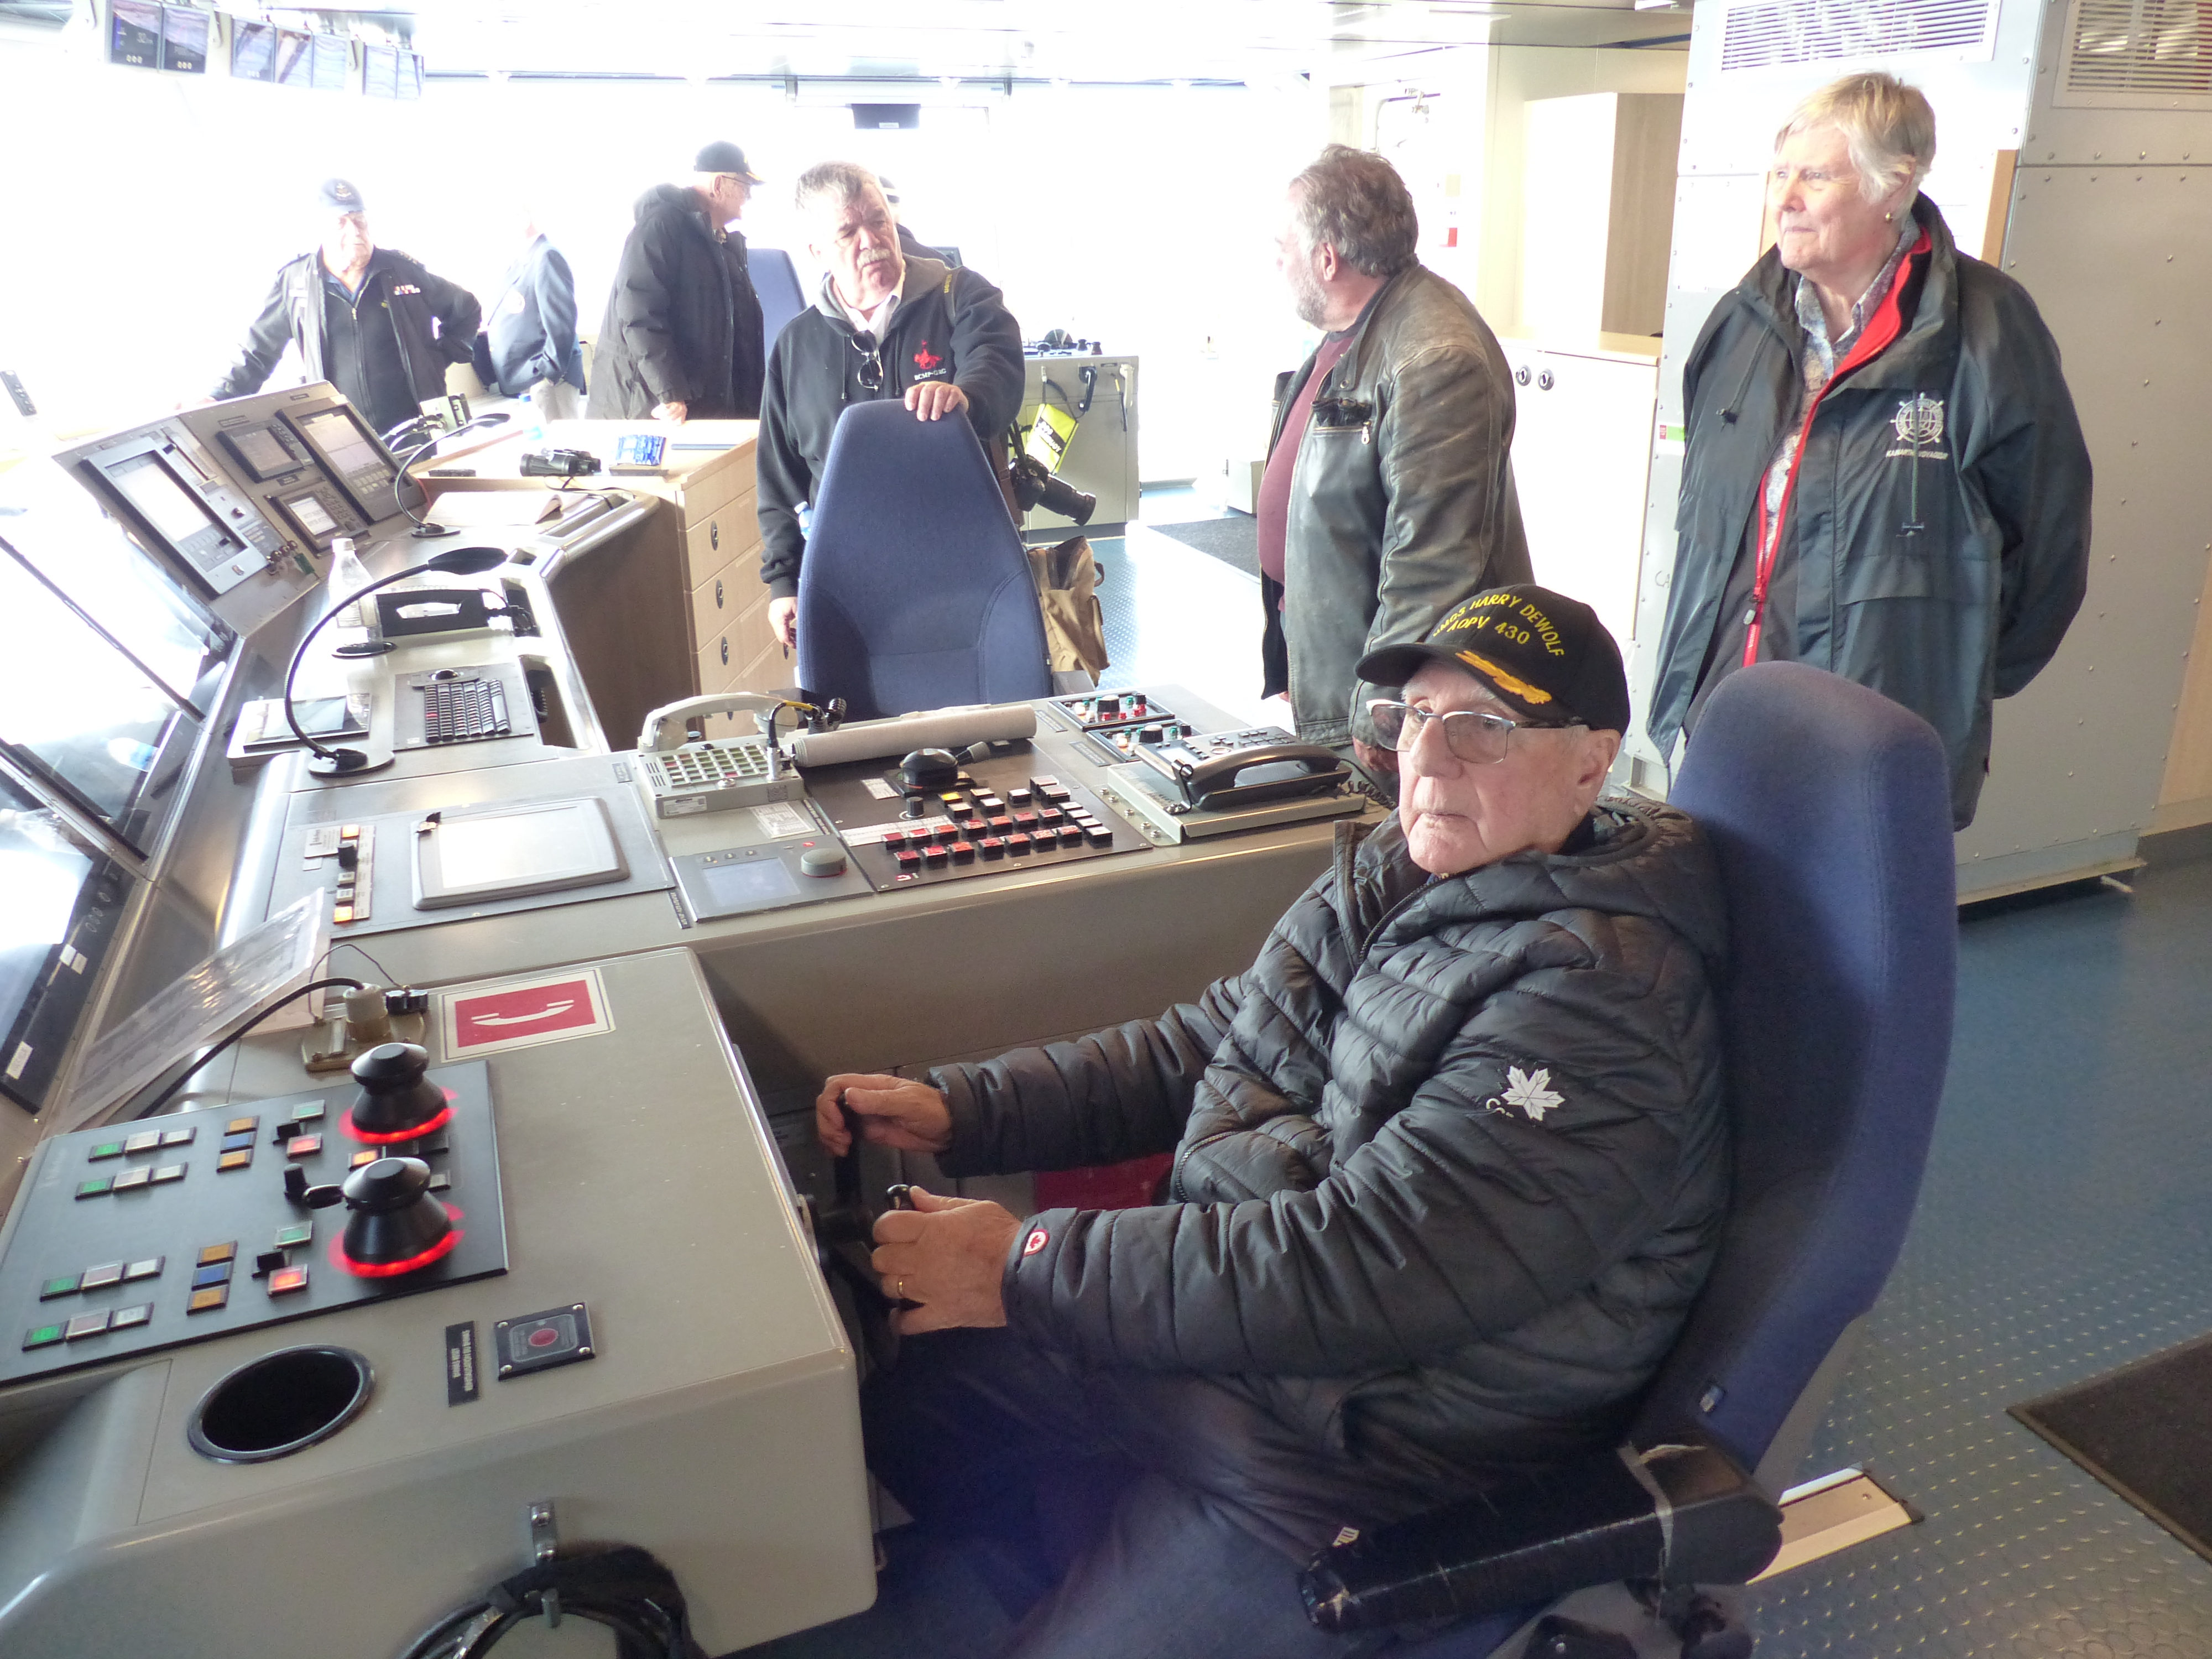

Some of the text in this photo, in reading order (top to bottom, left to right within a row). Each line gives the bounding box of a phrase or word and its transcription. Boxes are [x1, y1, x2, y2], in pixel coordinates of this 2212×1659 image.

[1446, 615, 1530, 645] AOPV 430
[1469, 593, 1522, 611] HARRY
[1519, 603, 1565, 656] DEWOLF
